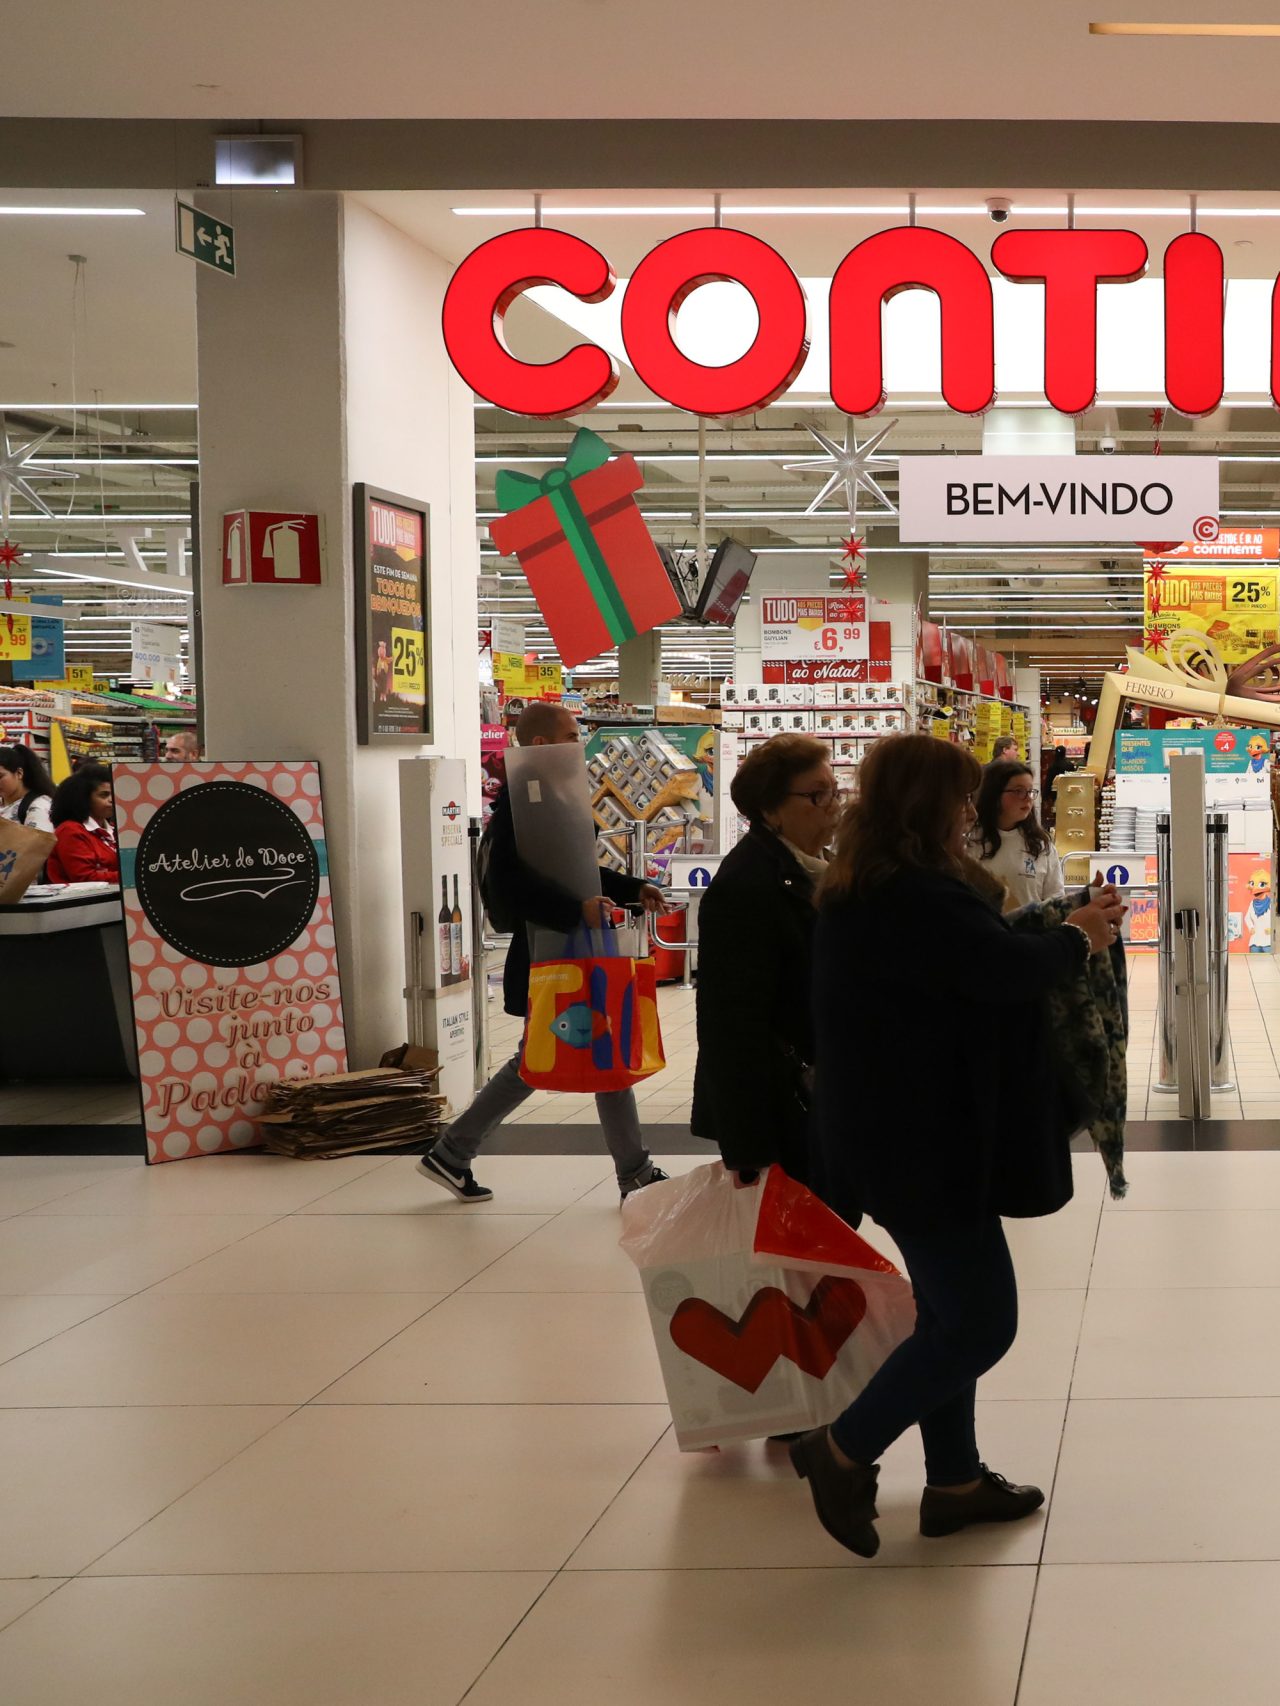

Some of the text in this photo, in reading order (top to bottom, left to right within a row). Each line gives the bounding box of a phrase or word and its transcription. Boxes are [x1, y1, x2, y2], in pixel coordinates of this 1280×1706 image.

[945, 482, 1173, 516] BEM-VINDO
[371, 505, 396, 546] TUDO
[1193, 545, 1263, 555] CONTINENTE
[373, 564, 384, 574] ESTE
[376, 577, 405, 598] TODOS
[1231, 581, 1271, 603] 25%
[764, 600, 798, 622] TUDO
[393, 636, 424, 677] 25%
[792, 663, 860, 678] ao Natal
[1125, 681, 1174, 701] FERRERO
[149, 847, 306, 872] Atelier do Doce
[161, 983, 331, 1018] Visite-nos
[226, 1012, 314, 1048] junto
[239, 1043, 262, 1069] à
